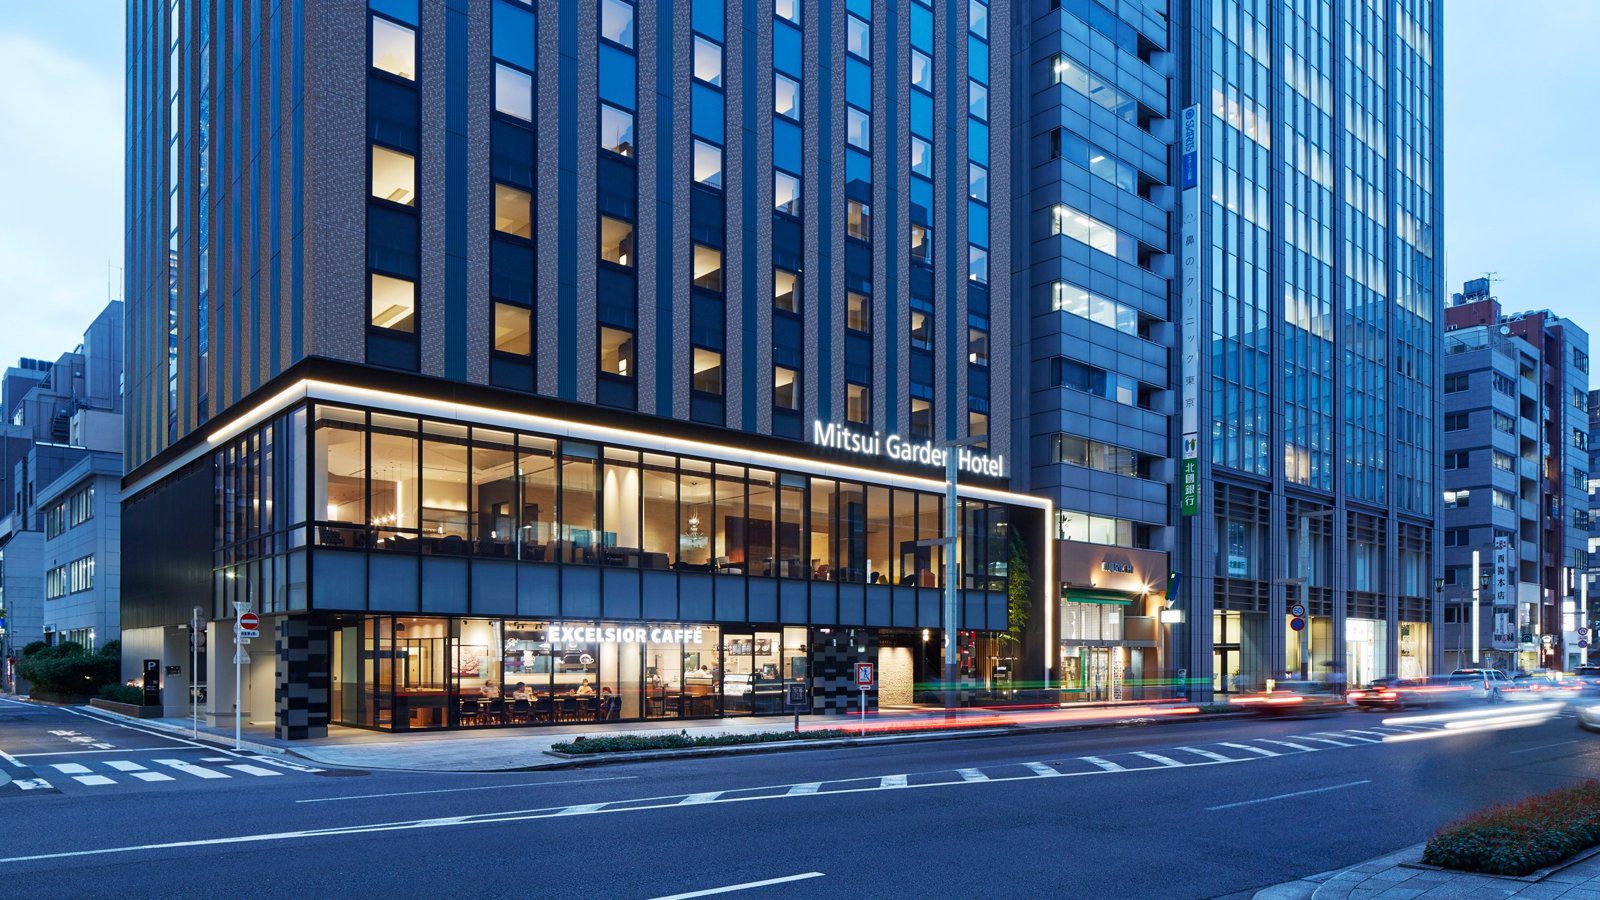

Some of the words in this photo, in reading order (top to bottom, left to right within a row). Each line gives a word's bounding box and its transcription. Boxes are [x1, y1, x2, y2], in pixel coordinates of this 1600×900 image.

[814, 420, 880, 456] Mitsui
[958, 448, 1003, 478] Hotel
[1185, 462, 1195, 506] 北國銀行
[549, 627, 647, 644] EXCELSIOR
[651, 626, 703, 644] CAFFÉ
[147, 661, 156, 671] P
